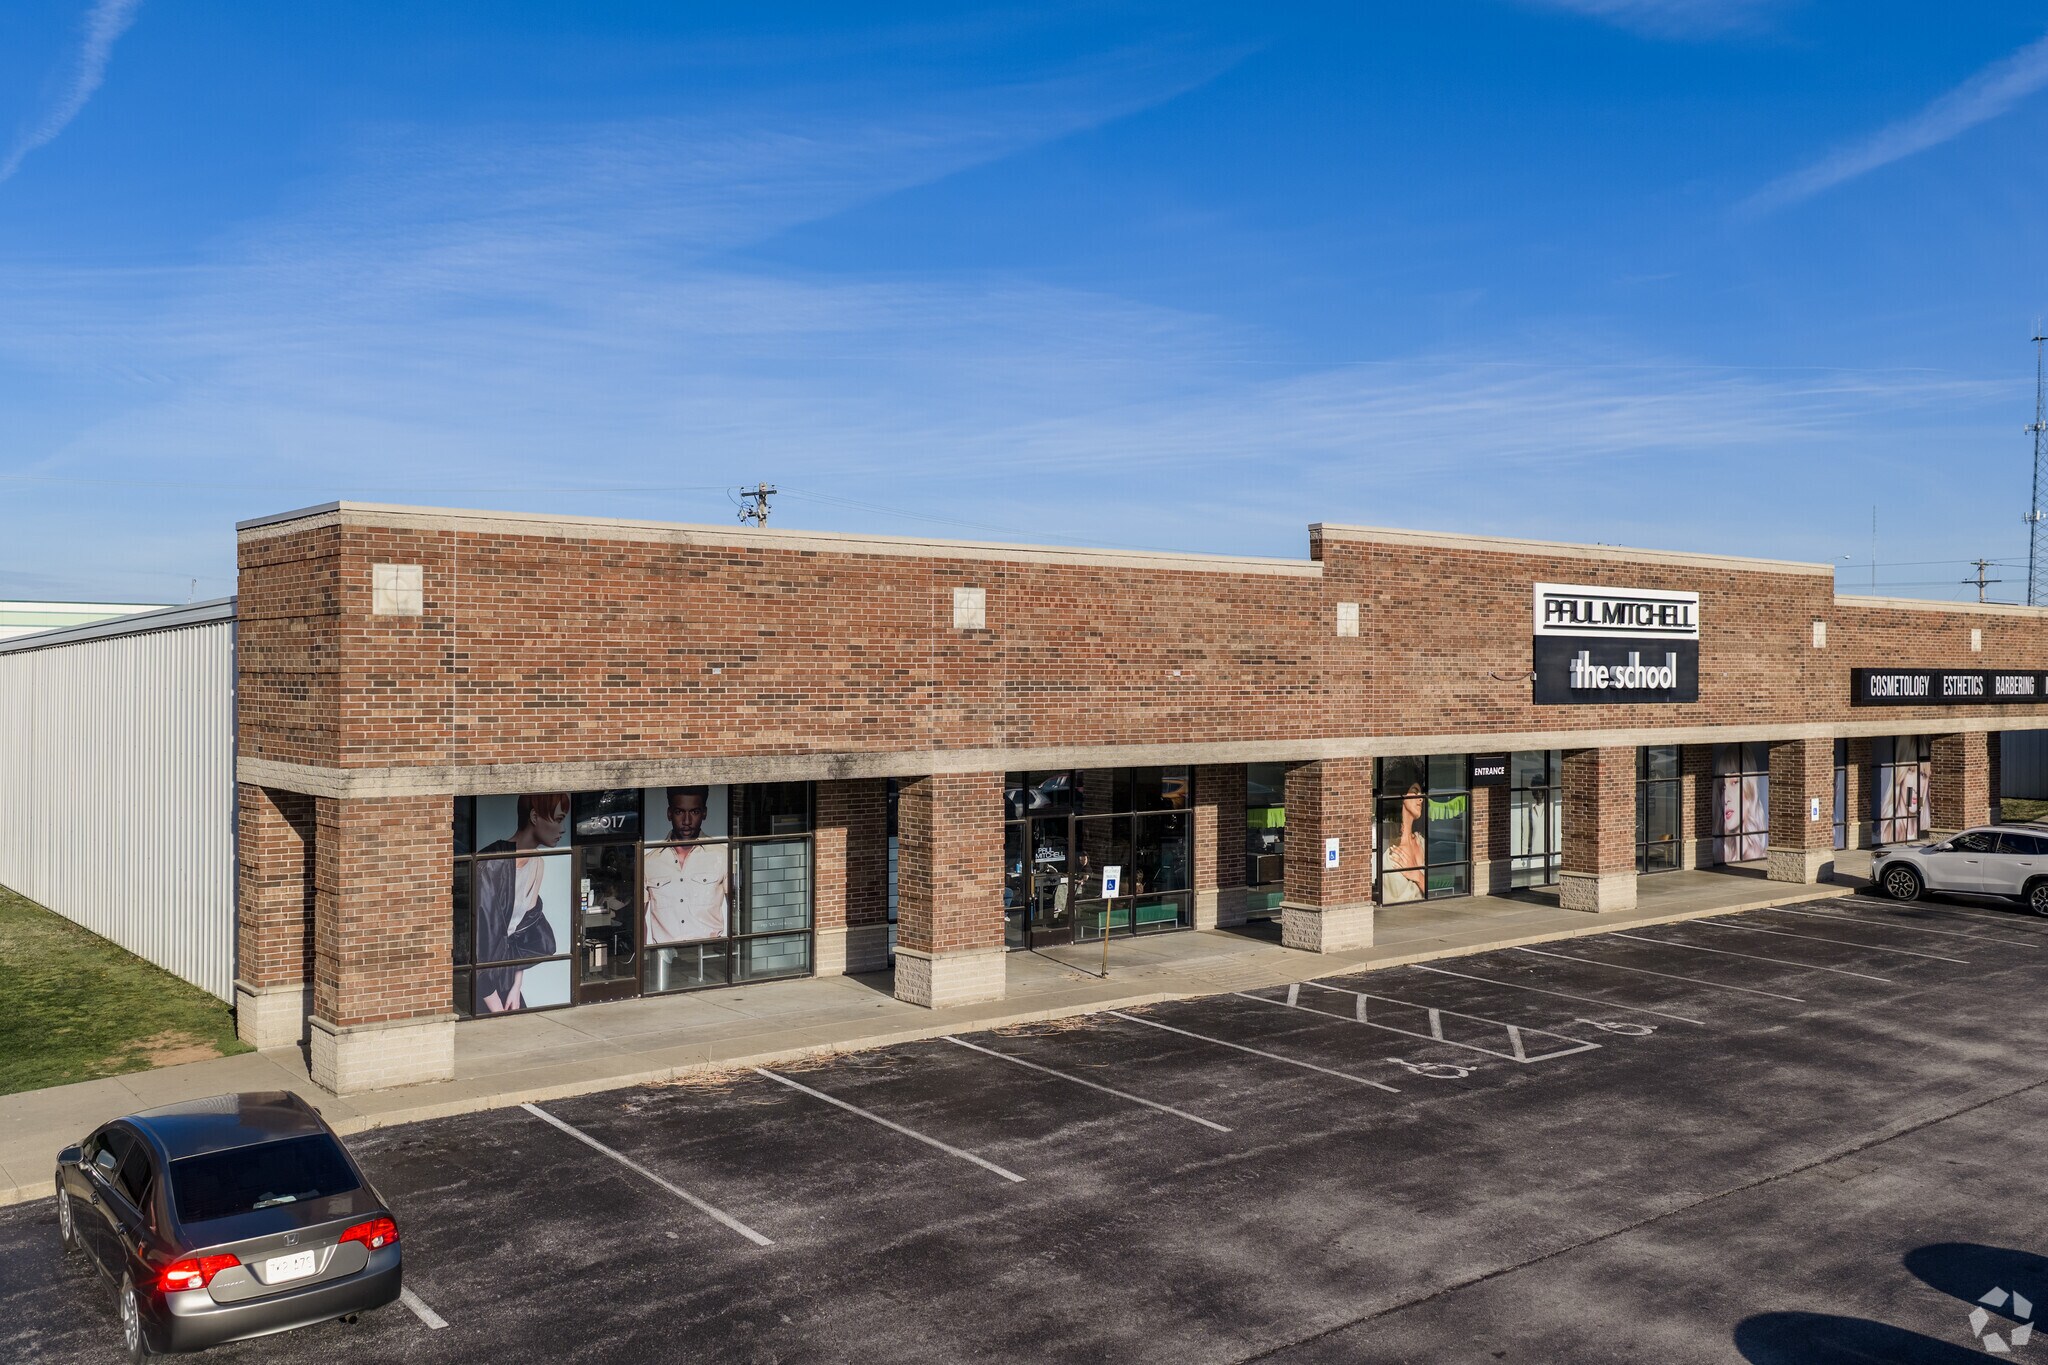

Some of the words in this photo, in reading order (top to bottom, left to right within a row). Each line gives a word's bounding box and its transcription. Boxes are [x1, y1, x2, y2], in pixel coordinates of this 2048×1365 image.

[1545, 599, 1601, 623] PAUL
[1602, 602, 1696, 627] MITCHELL
[1570, 650, 1610, 689] the
[1610, 651, 1677, 689] school
[1870, 675, 1930, 696] COSMETOLOGY
[1943, 675, 1984, 696] ESTHETICS
[1995, 675, 2035, 695] BARBERING
[1475, 766, 1505, 776] ENTRANCE
[590, 815, 626, 829] 3017
